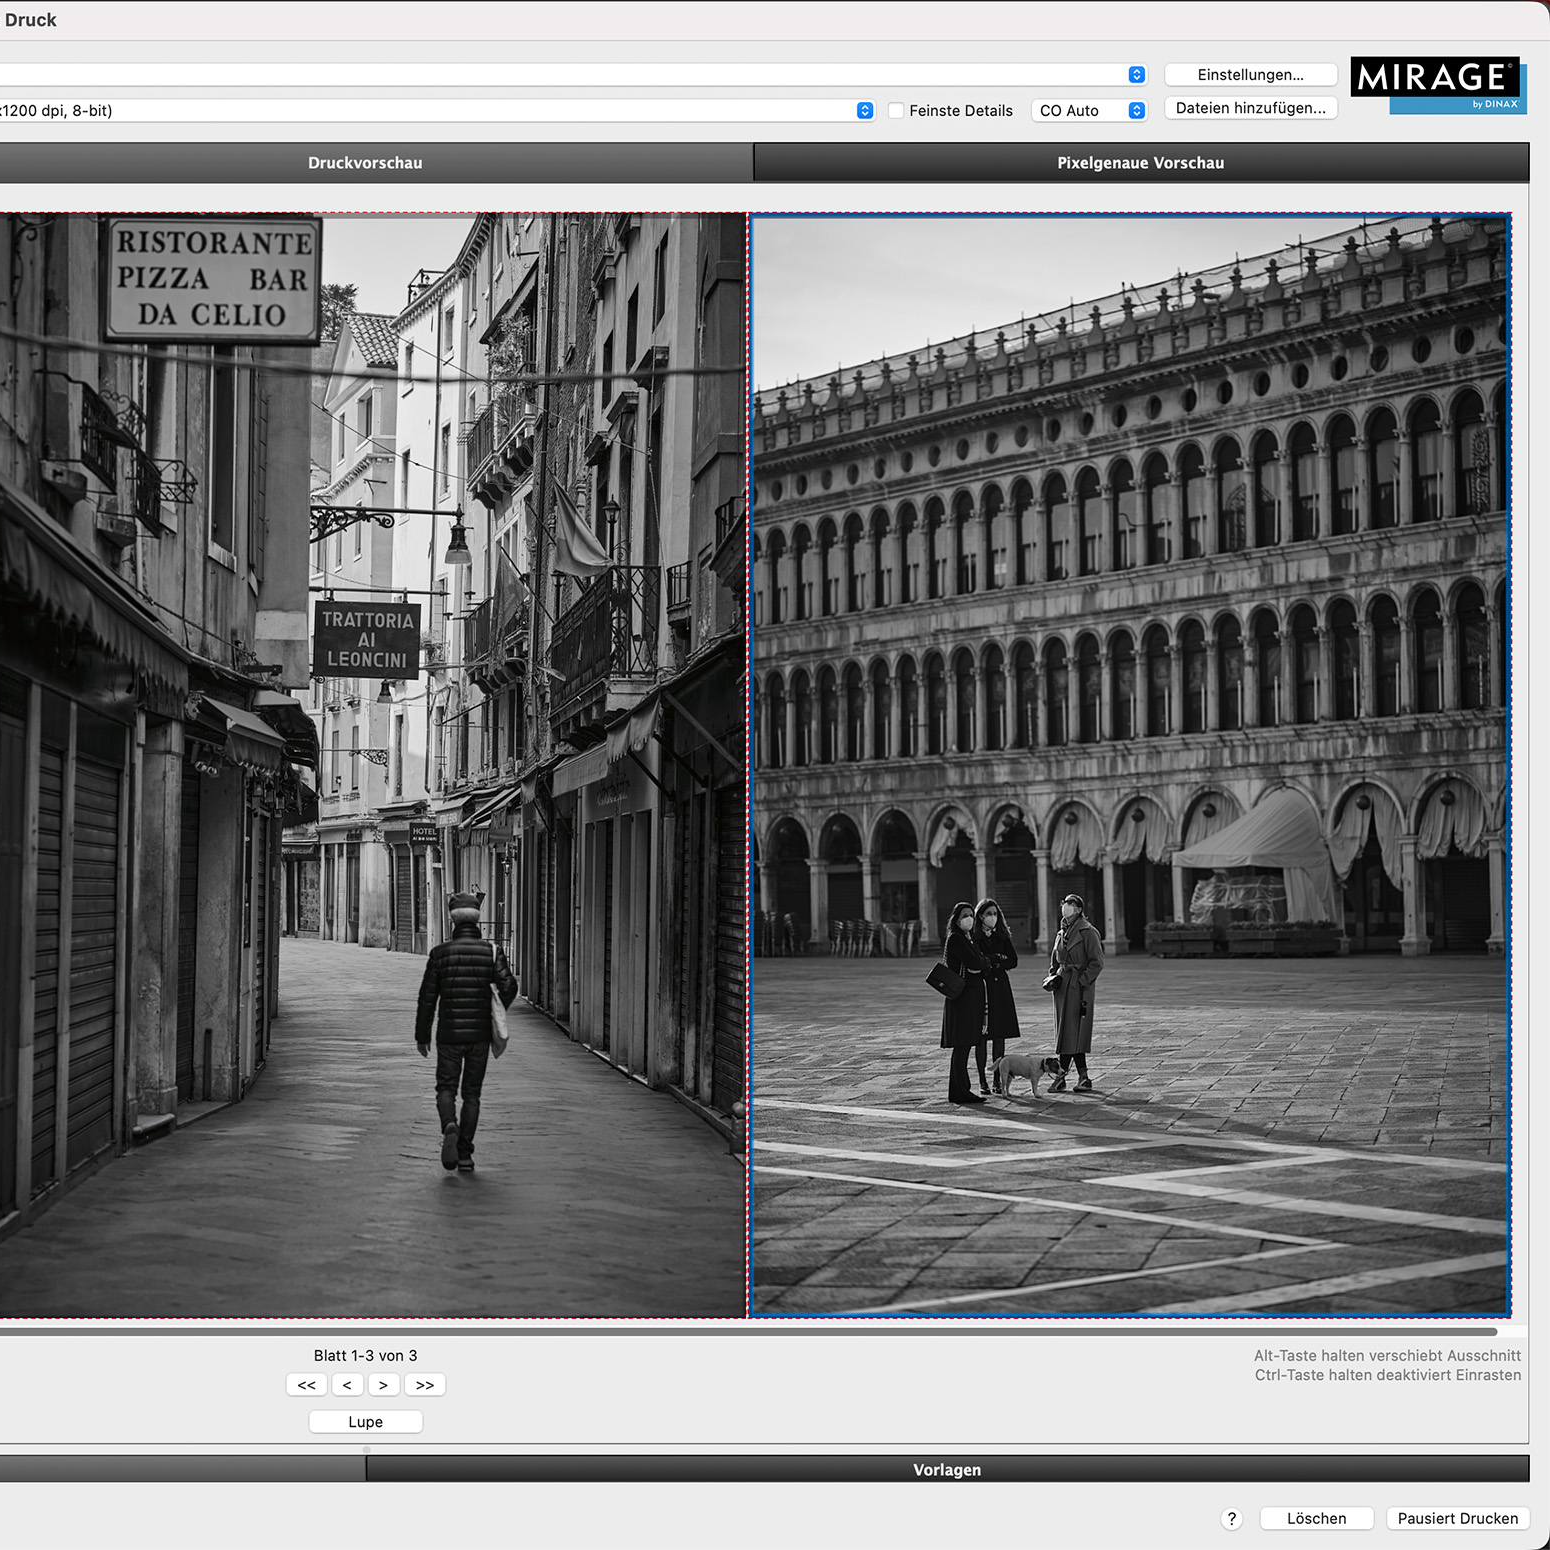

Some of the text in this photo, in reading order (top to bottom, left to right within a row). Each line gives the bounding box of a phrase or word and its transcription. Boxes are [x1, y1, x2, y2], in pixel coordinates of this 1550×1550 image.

[5, 11, 58, 28] Druck
[41, 103, 68, 120] dpi,
[72, 103, 113, 120] 8-bit)
[910, 103, 1014, 117] Feinste Details
[1040, 104, 1099, 117] CO Auto
[1176, 101, 1230, 115] Dateien
[1472, 99, 1484, 110] by
[308, 155, 423, 170] Druckvorschau
[1057, 155, 1225, 173] Pixelgenaue Vorschau
[117, 230, 312, 255] RISTORANTE
[117, 266, 308, 291] PIZZA BAR
[138, 303, 286, 327] DA CELIO
[322, 611, 415, 629] TRATTORIA
[357, 631, 376, 648] AI
[328, 650, 407, 668] LEONCINI
[412, 827, 438, 836] HOTEL
[314, 1348, 418, 1362] Blatt 1-3 von 3
[1253, 1348, 1522, 1362] Alt-Taste halten verschiebt Ausschnitt
[1255, 1368, 1522, 1382] Ctrl-Taste halten deaktiviert Einrasten
[349, 1415, 384, 1431] Lupe
[912, 1462, 982, 1480] Vorlagen
[1287, 1511, 1347, 1525] Löschen
[1398, 1511, 1519, 1525] Pausiert Drucken
